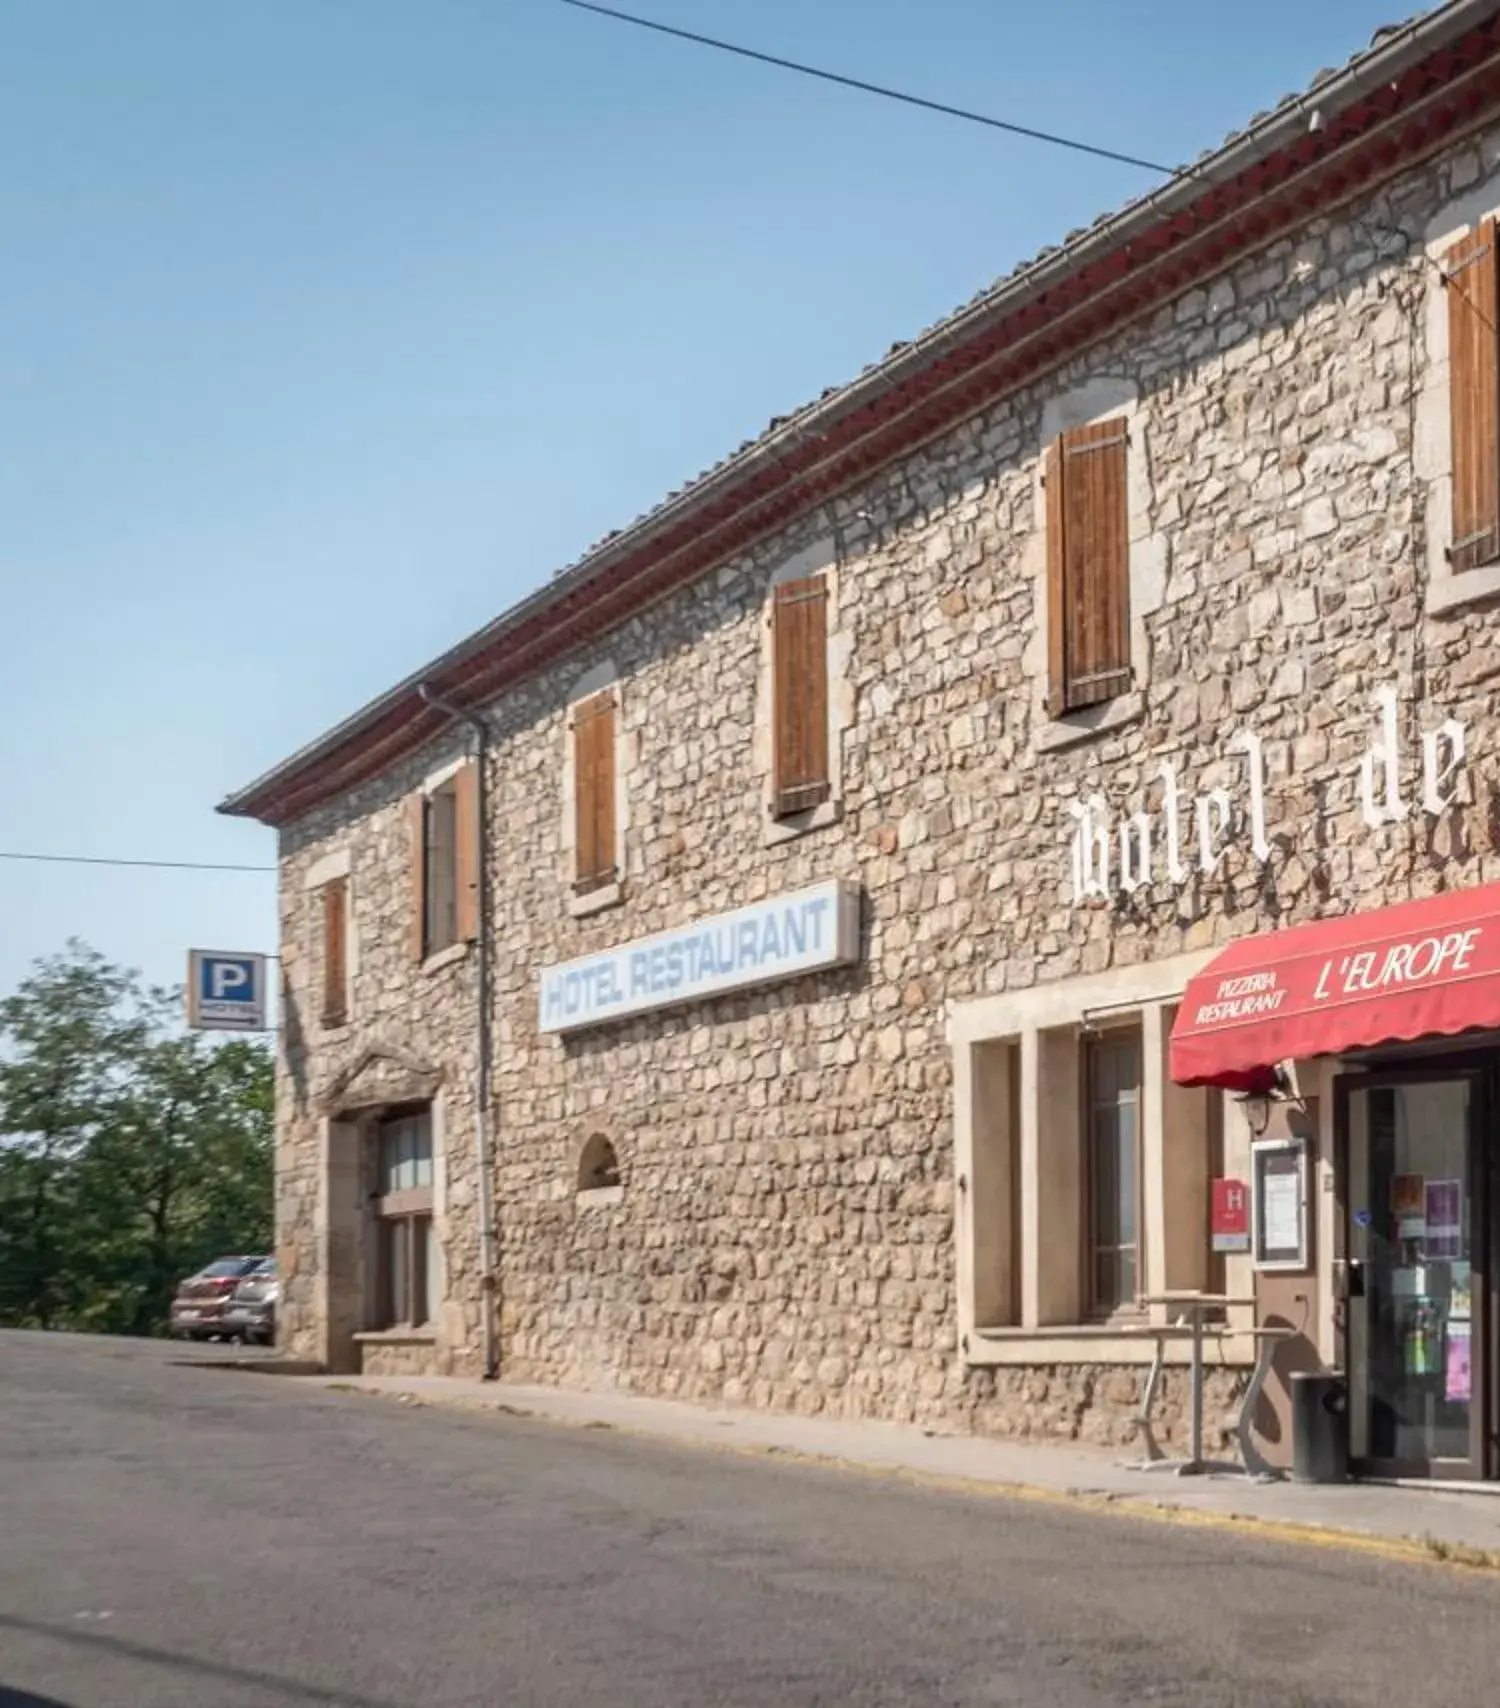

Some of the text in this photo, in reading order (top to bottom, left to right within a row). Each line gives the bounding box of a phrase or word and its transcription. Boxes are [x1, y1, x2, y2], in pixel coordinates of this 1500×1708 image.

[1358, 682, 1468, 829] de
[212, 962, 248, 998] P
[545, 896, 828, 1025] HOTEL RESTAURANT
[1216, 971, 1278, 999] PIZZERIA
[1313, 927, 1484, 1000] L'EUROPE
[1195, 989, 1289, 1025] RESTAURANT
